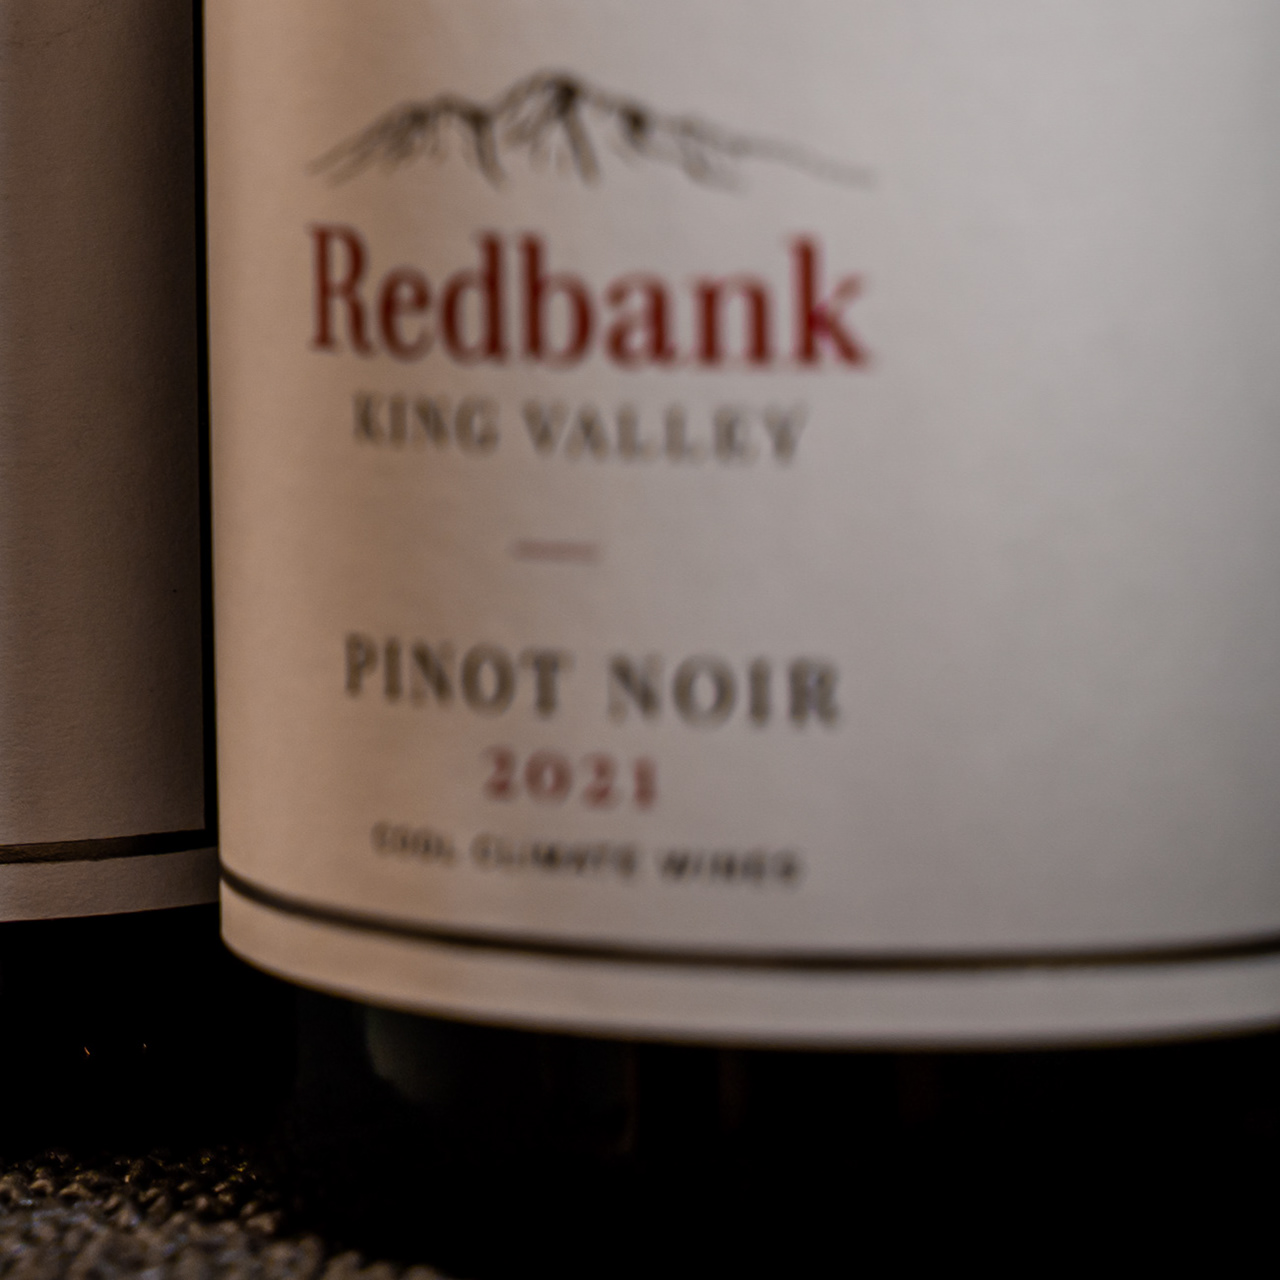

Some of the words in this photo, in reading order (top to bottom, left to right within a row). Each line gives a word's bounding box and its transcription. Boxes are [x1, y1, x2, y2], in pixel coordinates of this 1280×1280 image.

[307, 220, 874, 371] Redbank
[351, 390, 502, 457] KING
[518, 398, 808, 466] VALLEY
[343, 632, 576, 717] PINOT
[607, 652, 840, 731] NOIR
[484, 743, 660, 812] 2021
